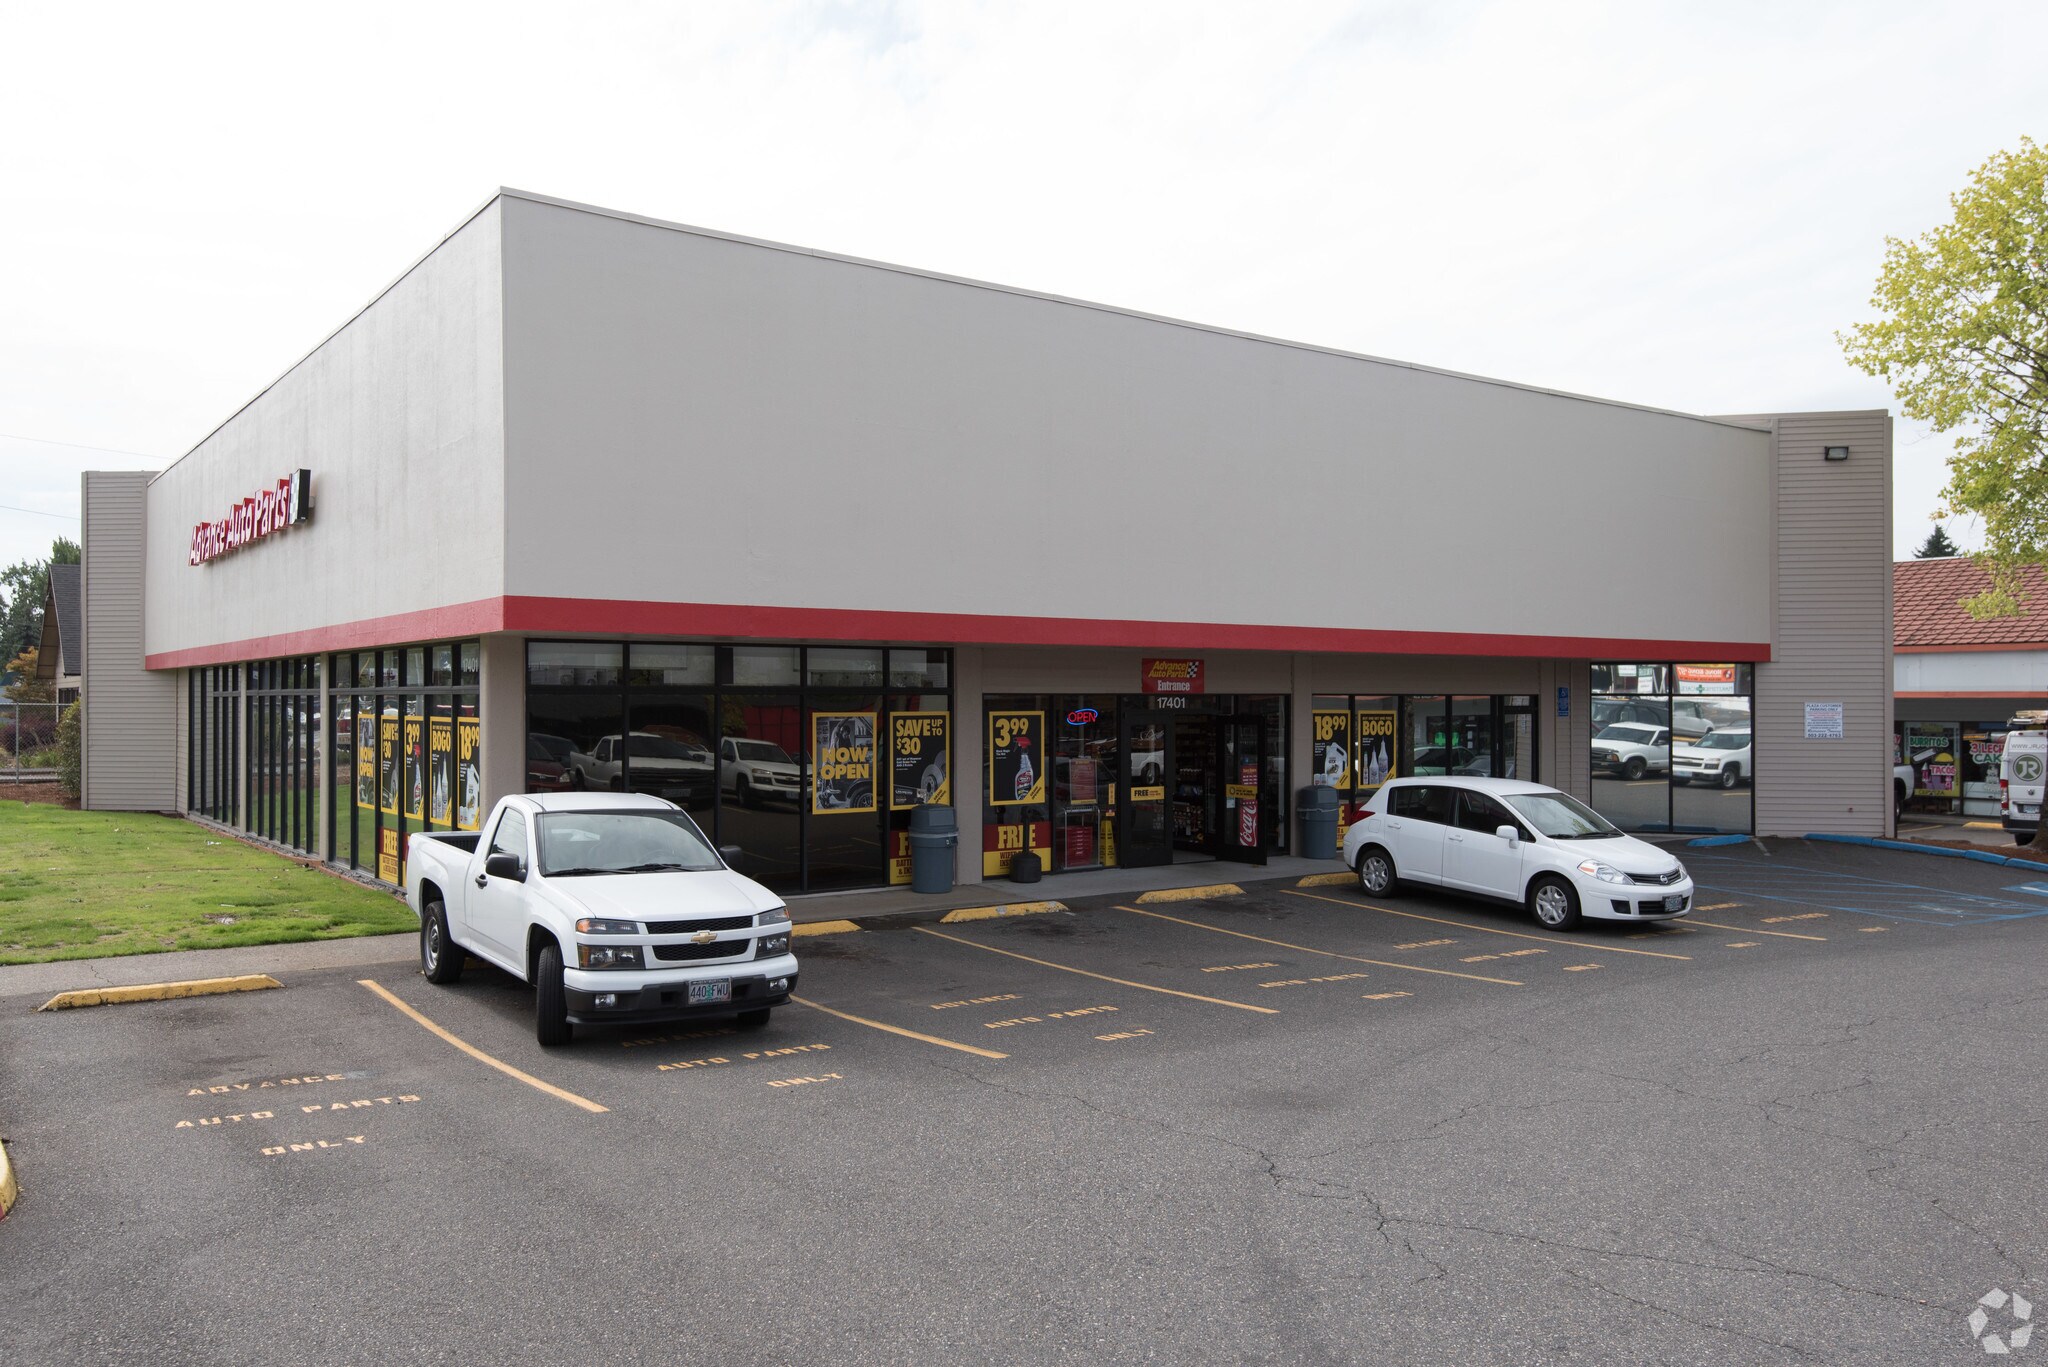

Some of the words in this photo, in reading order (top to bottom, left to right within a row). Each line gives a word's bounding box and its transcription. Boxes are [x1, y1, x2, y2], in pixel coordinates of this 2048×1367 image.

[189, 520, 226, 566] Advance
[226, 504, 255, 550] Auto
[253, 479, 290, 538] Parts
[1148, 670, 1166, 678] Auto
[1166, 670, 1185, 678] Parts
[1152, 661, 1187, 671] Advance
[1157, 680, 1191, 692] Entrance
[1156, 697, 1186, 709] 17401
[1068, 711, 1096, 723] OPEN
[896, 719, 931, 737] SAVE
[931, 719, 943, 727] UP
[932, 728, 943, 736] TO
[1362, 720, 1393, 736] BOGO
[432, 730, 452, 752] BOGO
[896, 737, 921, 755] $30
[1910, 736, 1948, 747] BURRITOS
[1972, 743, 1978, 753] 3
[822, 746, 869, 763] NOW
[1974, 754, 2002, 763] CAK
[821, 763, 870, 780] OPEN
[1931, 766, 1956, 775] TACOS
[691, 986, 706, 998] 440
[984, 1016, 1044, 1029] AUTO
[1047, 1005, 1120, 1019] PARTS
[1094, 1028, 1155, 1041] ONLY
[657, 1057, 731, 1071] AUTO
[742, 1043, 832, 1060] PARTS
[188, 1073, 346, 1096] ADVANCE
[766, 1072, 843, 1088] ONLY
[175, 1111, 274, 1128] AUTO
[302, 1094, 421, 1114] PARTS
[261, 1135, 365, 1156] ONLY
